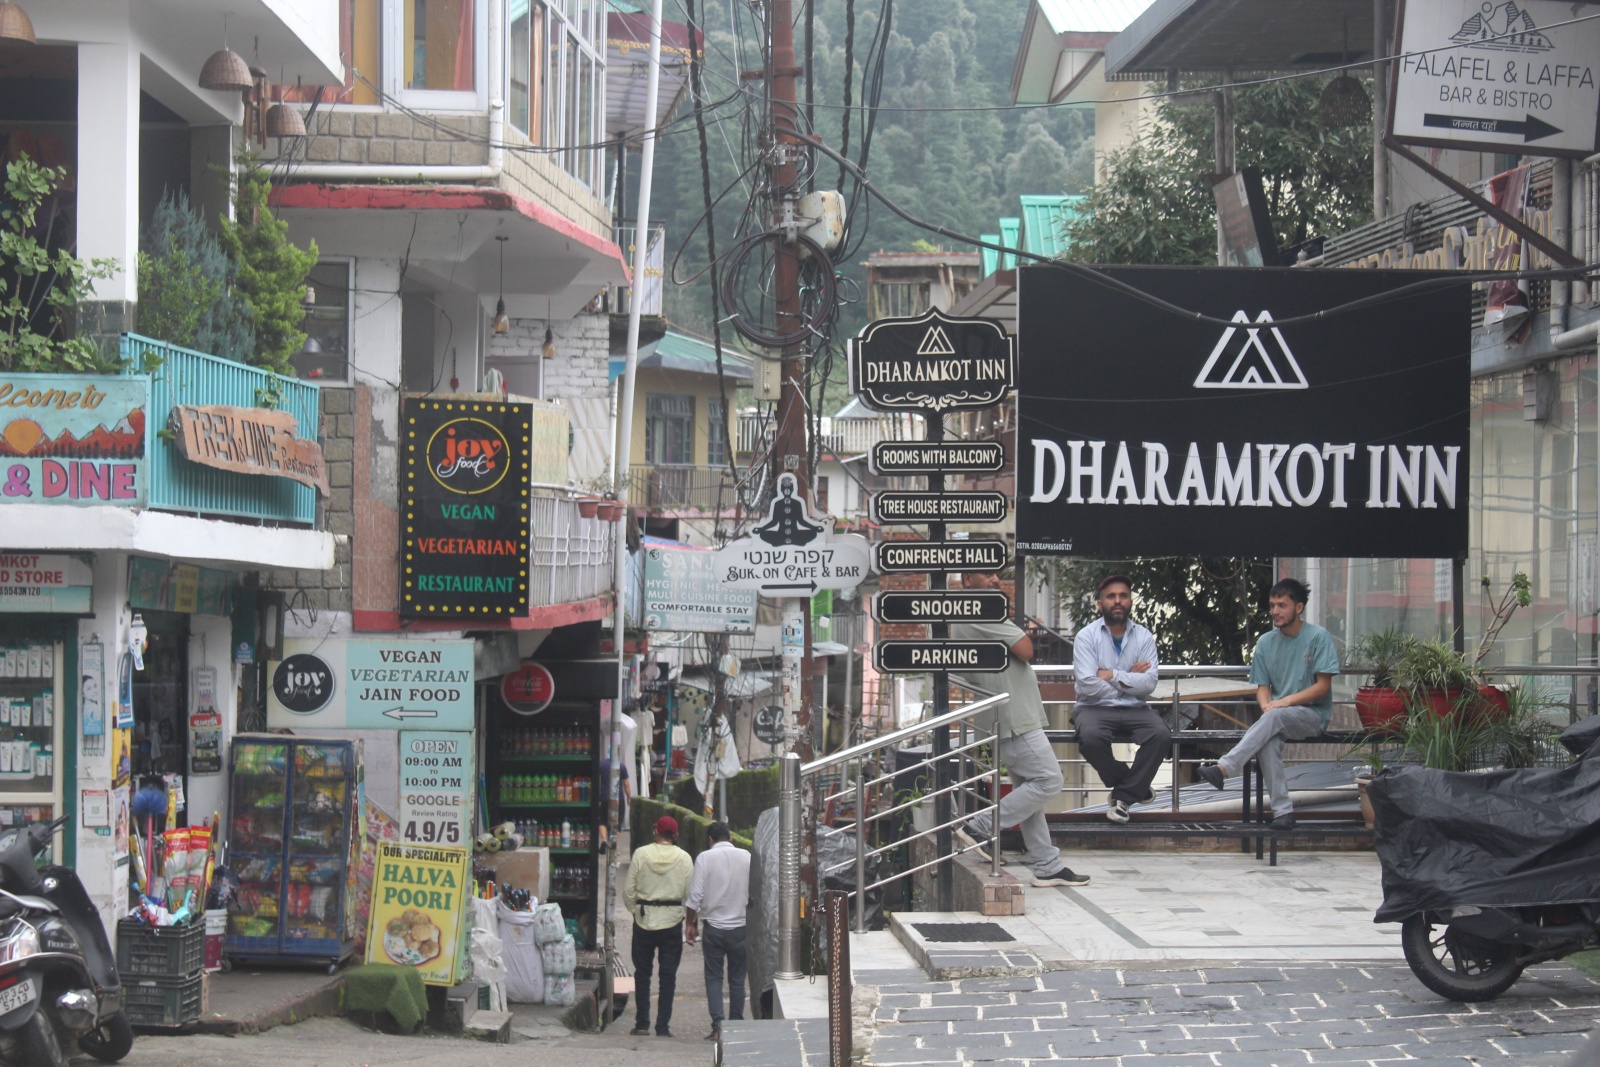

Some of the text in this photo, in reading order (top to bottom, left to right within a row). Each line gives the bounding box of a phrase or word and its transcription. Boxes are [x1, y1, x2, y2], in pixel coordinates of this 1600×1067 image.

[1403, 52, 1594, 89] FALAFEL & LAFFA
[1439, 85, 1552, 110] BAR & BISTRO
[867, 359, 1006, 383] DHARAMKOT INN
[185, 408, 240, 462] TREK
[241, 420, 281, 470] DINE
[882, 449, 997, 464] ROOMS WITH BALCONY
[3, 460, 137, 501] & DINE
[1030, 439, 1461, 510] DHARAMKOT INN
[441, 504, 496, 520] VEGAN
[883, 499, 1001, 514] TREE HOUSE RESTAURANT
[418, 537, 517, 556] VEGETARIAN
[744, 550, 834, 568] קפה שנטי
[887, 548, 999, 564] CONFRENCE HALL
[15, 570, 63, 584] STORE
[822, 567, 831, 577] &
[836, 566, 859, 577] BAR
[418, 575, 515, 593] RESTAURANT
[724, 594, 752, 604] FOOD
[651, 603, 749, 614] COMFORTABLE STAY
[911, 600, 982, 615] SNOOKER
[379, 650, 442, 663] VEGAN
[912, 649, 978, 664] PARKING
[284, 663, 325, 695] joy
[351, 669, 470, 683] VEGETARIAN
[360, 688, 460, 702] JAIN FOOD
[411, 739, 458, 754] OPEN
[405, 757, 462, 767] 09:00 AM
[405, 777, 462, 787] 10:00 PM
[407, 795, 460, 806] GOOGLE
[412, 809, 458, 819] Review Rating
[404, 821, 460, 843] 4.9/5
[383, 846, 461, 864] OUR SPECIALITY
[382, 863, 457, 888] HALVA
[383, 886, 452, 910] POORI
